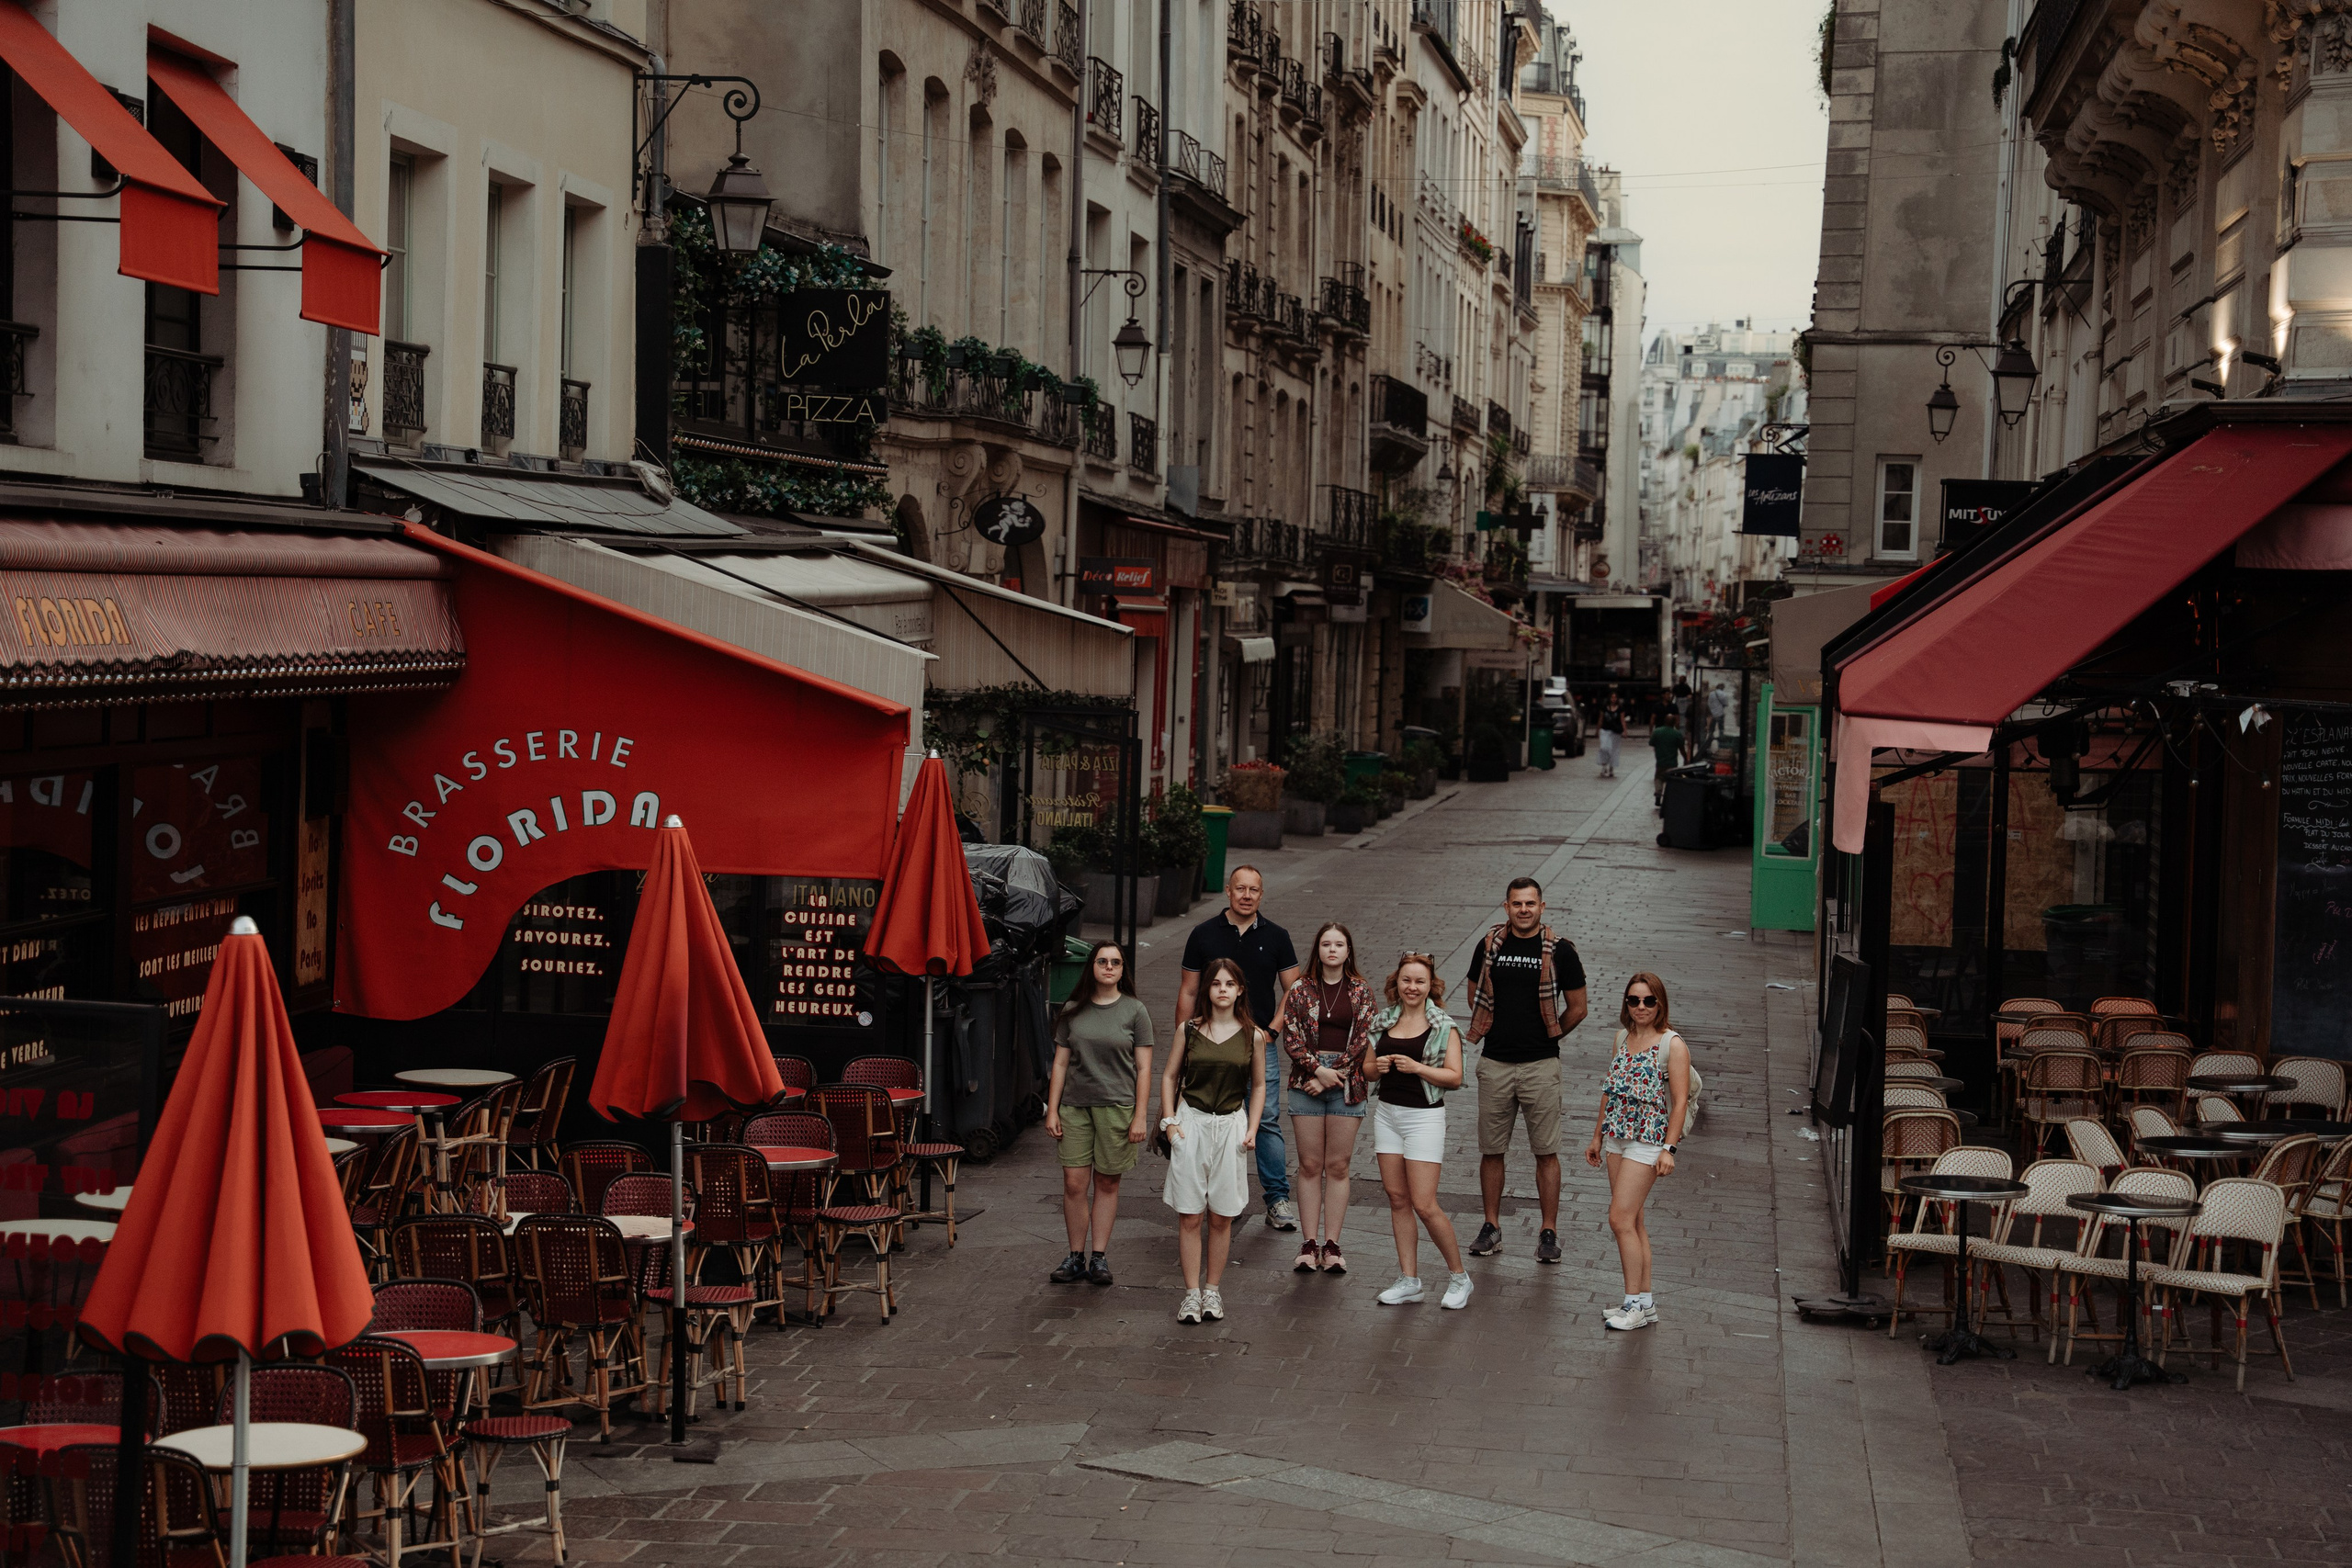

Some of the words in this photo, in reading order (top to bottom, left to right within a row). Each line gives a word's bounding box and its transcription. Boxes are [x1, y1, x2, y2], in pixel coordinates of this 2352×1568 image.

[782, 334, 821, 378] La
[807, 293, 885, 352] Perla
[787, 394, 876, 424] PIZZA
[1754, 486, 1799, 505] Artizans
[1082, 570, 1114, 581] Déco
[1116, 570, 1150, 586] Relief
[16, 596, 131, 647] FLORIDA
[348, 601, 401, 637] CAFE
[387, 728, 635, 857] BRASSERIE
[309, 832, 319, 852] No
[428, 789, 661, 931] FLORIDA
[301, 870, 323, 897] Spritz
[809, 895, 828, 908] LA
[135, 914, 150, 932] LES
[153, 908, 180, 930] REPAS
[184, 902, 210, 922] ENTRE
[213, 897, 235, 916] AMIS
[306, 909, 317, 930] No
[523, 903, 605, 921] SIROTEZ.
[784, 910, 856, 927] CUISINE
[514, 930, 611, 948] SAVOUREZ.
[805, 930, 834, 942] EST
[12, 939, 40, 964] DANS
[139, 956, 164, 979] SONT
[166, 953, 181, 971] LES
[184, 943, 222, 967] MEILLEU
[300, 946, 322, 972] Party
[834, 949, 855, 961] DE
[520, 958, 604, 976] SOURIEZ.
[783, 964, 852, 979] RENDRE
[779, 981, 806, 995] LES
[814, 983, 856, 997] GENS
[775, 1000, 861, 1017] HEUREUX.
